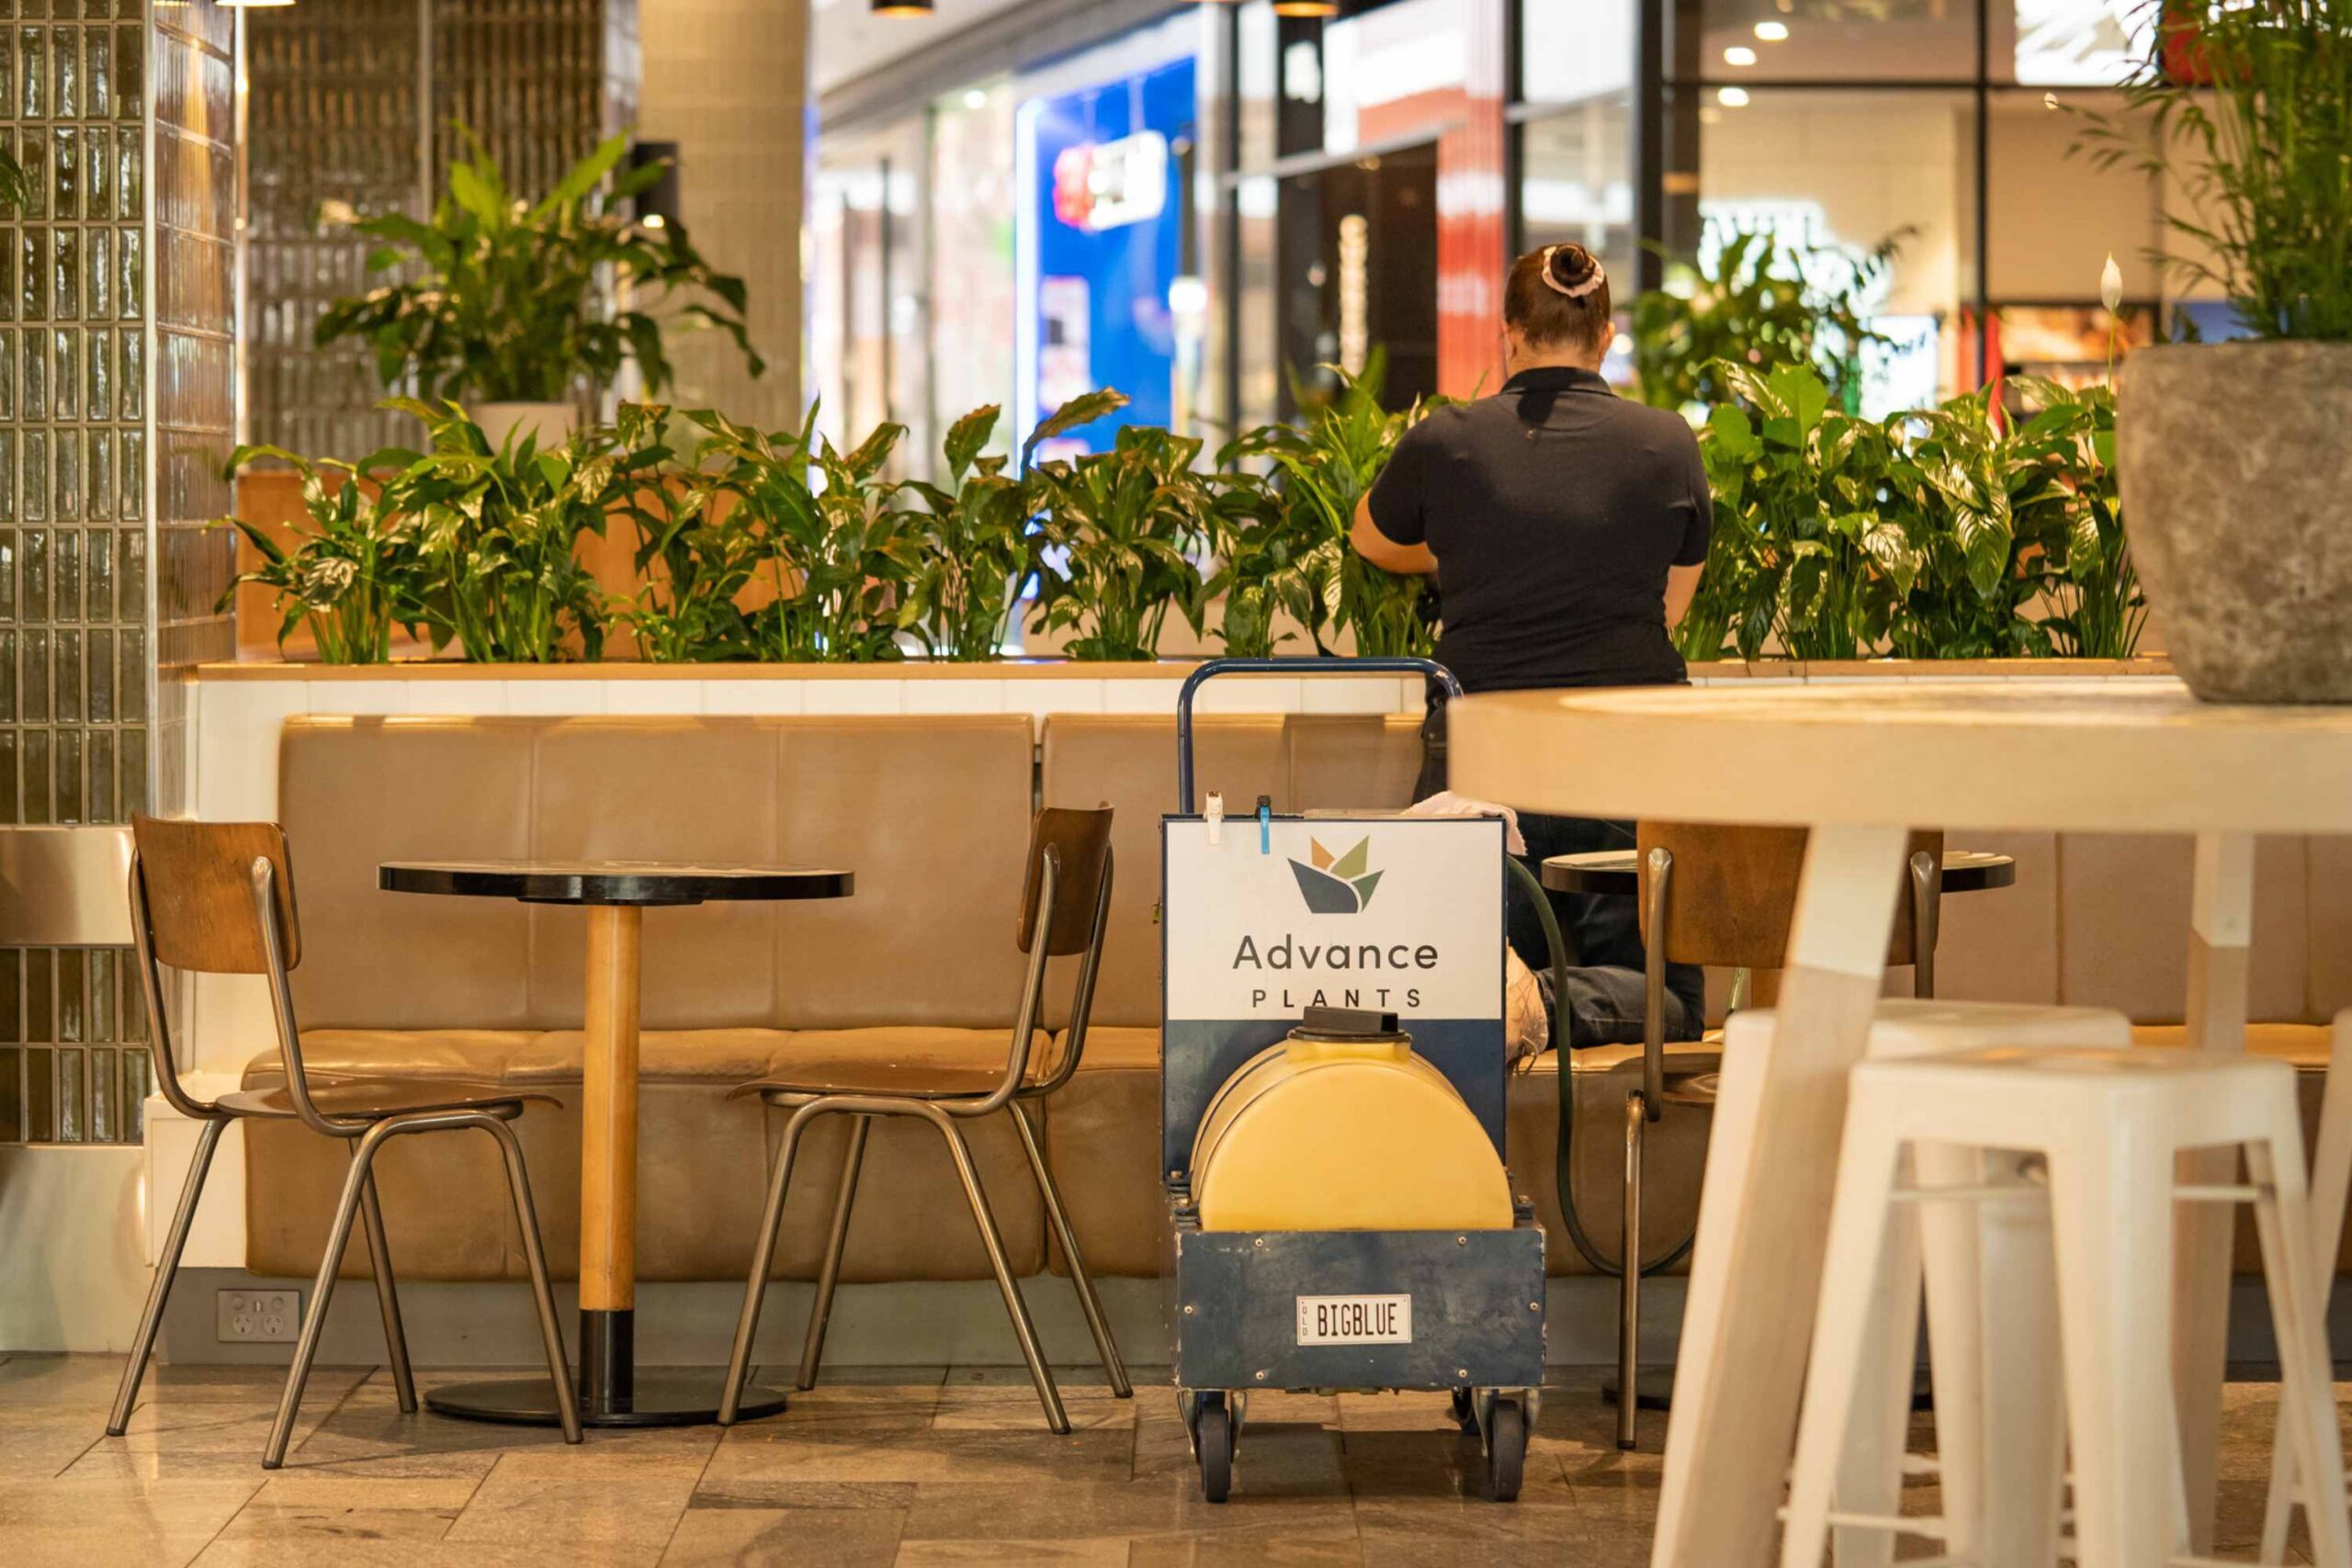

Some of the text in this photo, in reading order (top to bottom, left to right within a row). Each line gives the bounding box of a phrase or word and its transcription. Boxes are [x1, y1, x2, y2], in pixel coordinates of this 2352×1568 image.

[1232, 933, 1439, 970] Advance
[1252, 988, 1421, 1008] PLANTS
[1317, 1303, 1397, 1337] BIGBLUE
